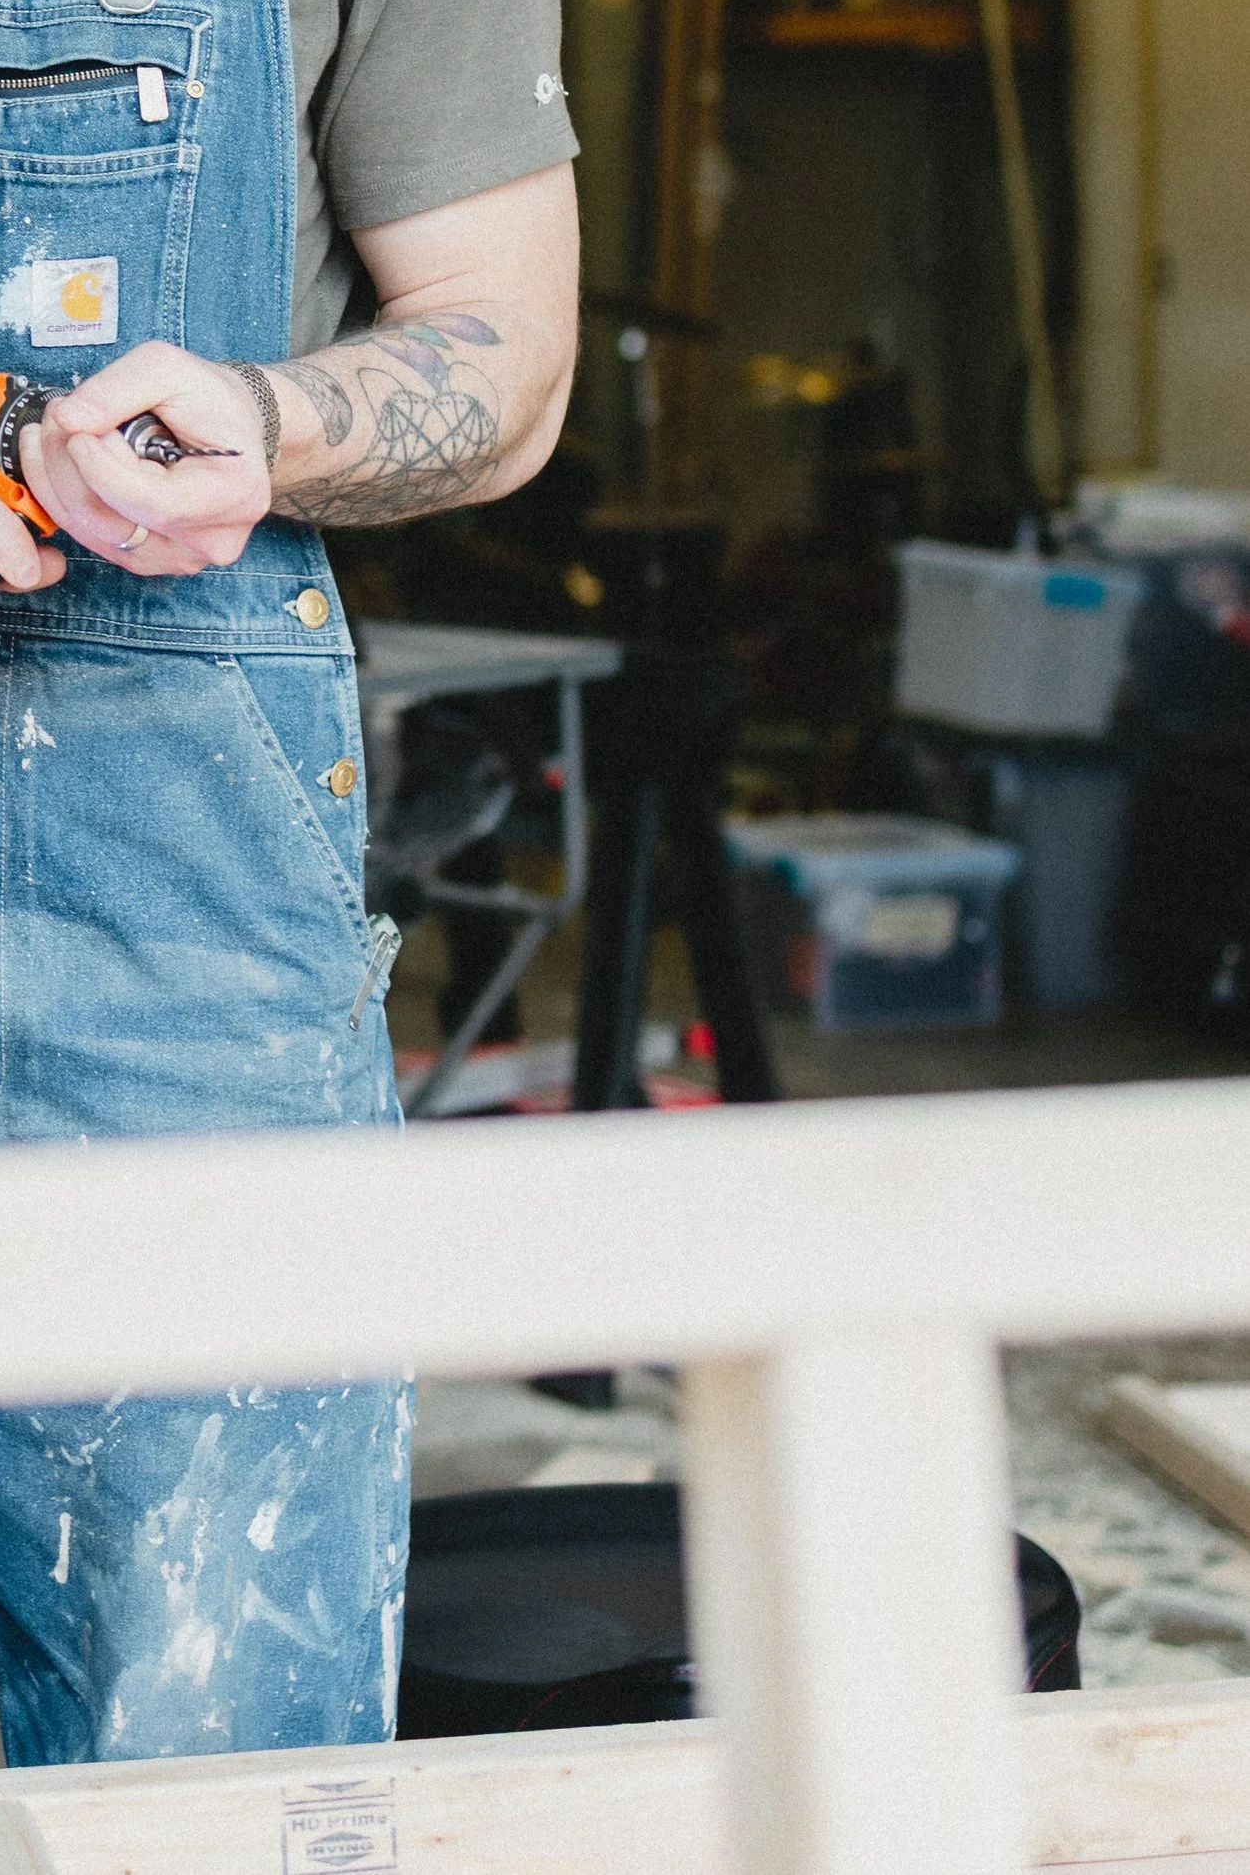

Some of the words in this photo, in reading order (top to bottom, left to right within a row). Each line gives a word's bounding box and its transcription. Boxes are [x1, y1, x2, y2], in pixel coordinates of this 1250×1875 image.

[46, 322, 103, 333] carhartt
[4, 422, 15, 436] 16
[3, 456, 13, 470] 18
[291, 1817, 321, 1832] HD
[327, 1813, 388, 1829] Prime
[306, 1841, 375, 1856] IRVING
